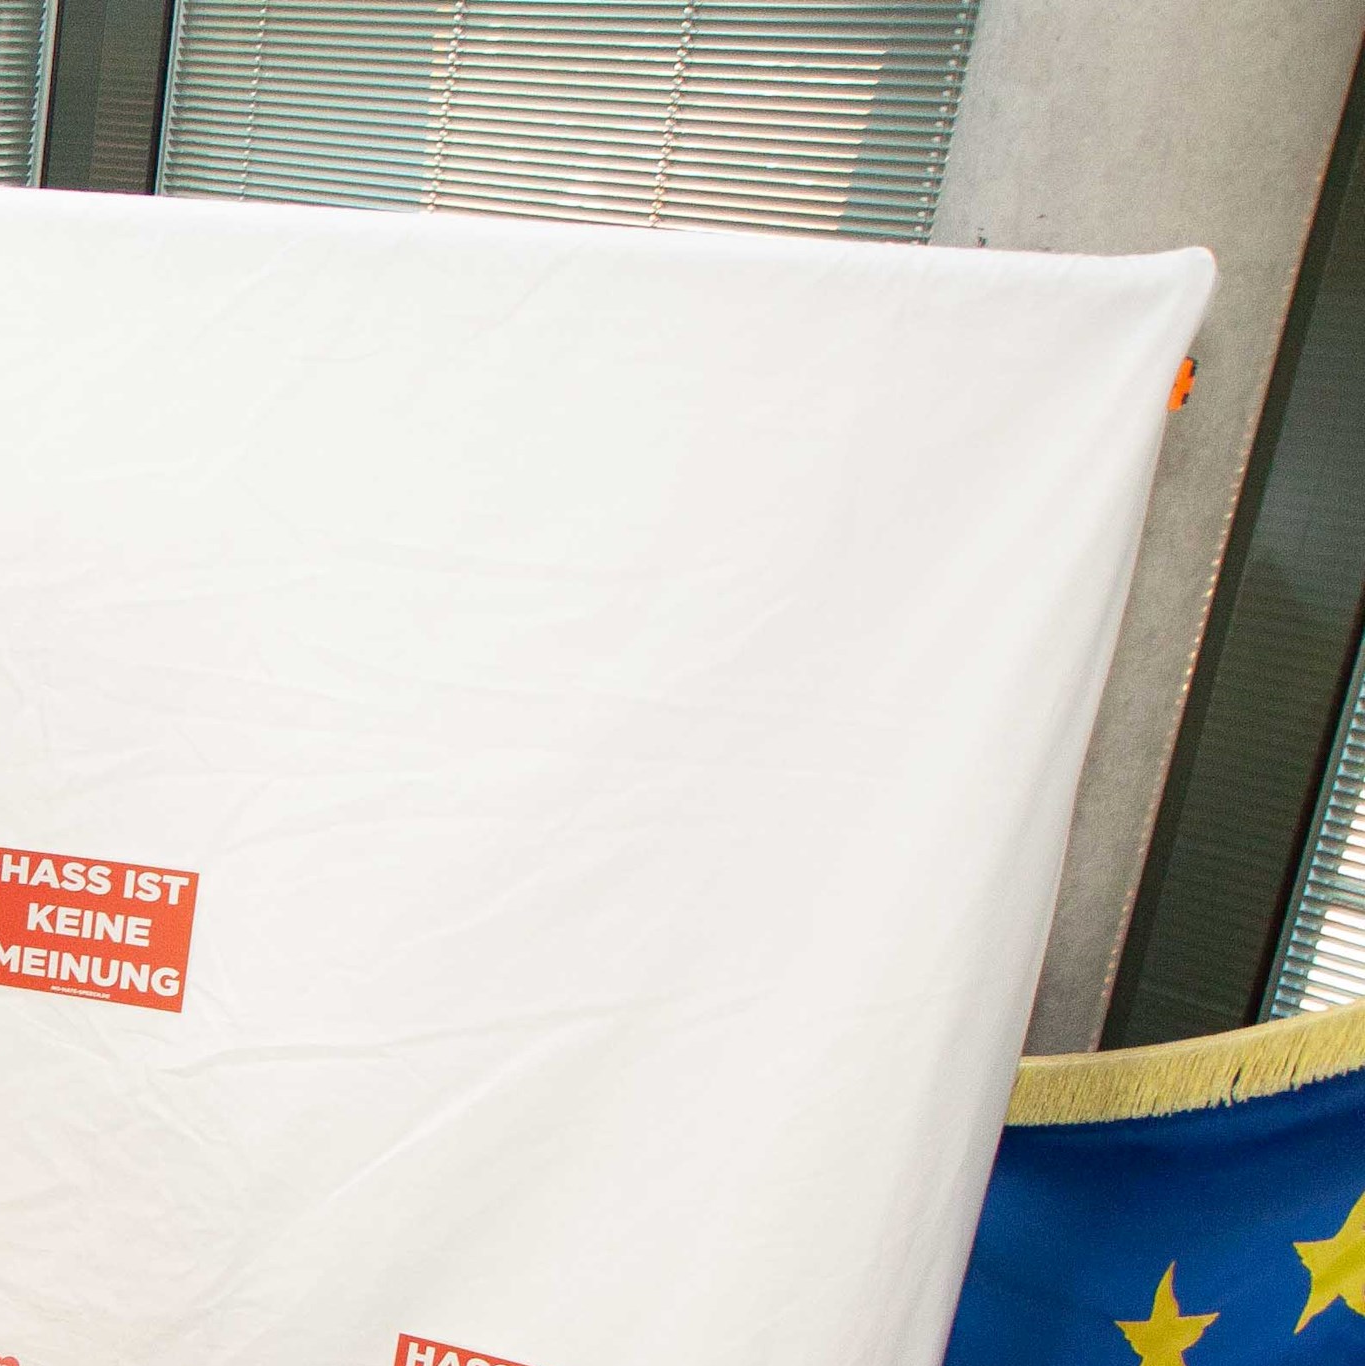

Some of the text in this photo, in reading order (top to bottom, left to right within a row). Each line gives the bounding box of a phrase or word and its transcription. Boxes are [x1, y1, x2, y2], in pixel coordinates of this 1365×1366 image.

[1, 854, 189, 905] HASS IST
[27, 903, 152, 947] KEINE
